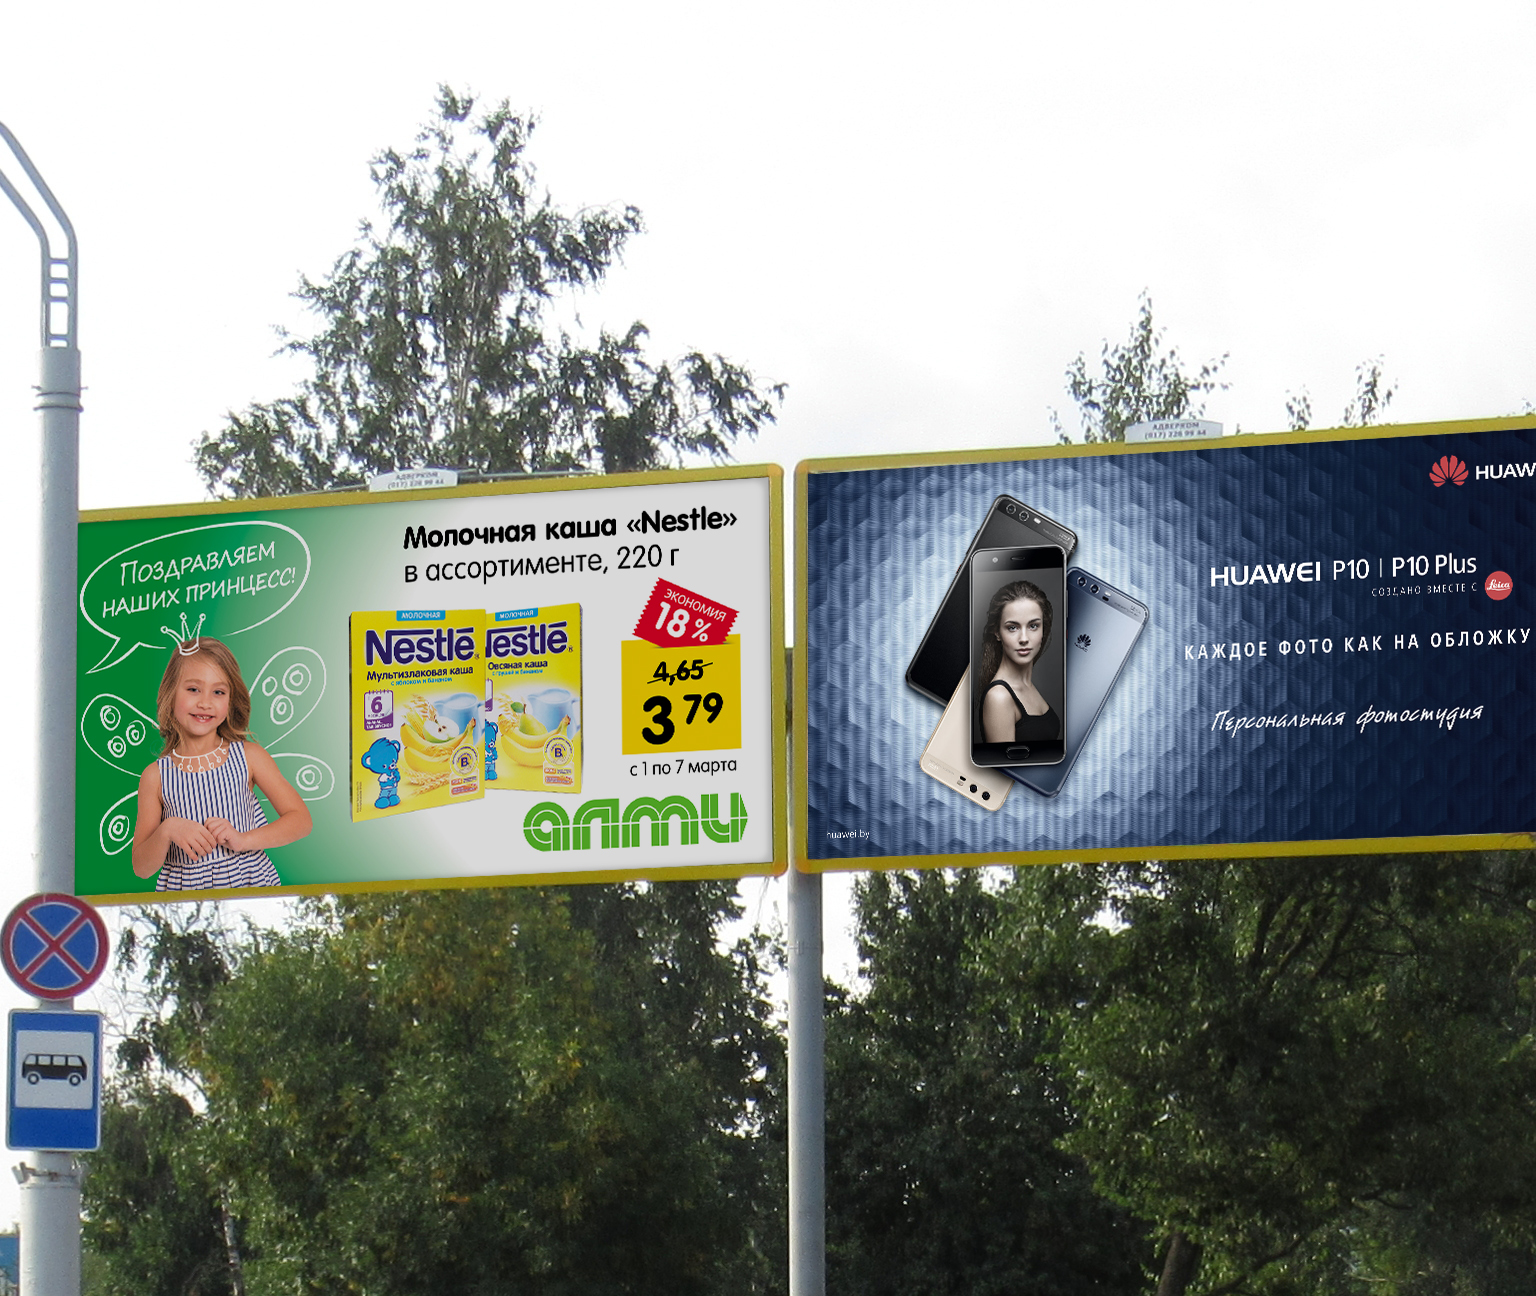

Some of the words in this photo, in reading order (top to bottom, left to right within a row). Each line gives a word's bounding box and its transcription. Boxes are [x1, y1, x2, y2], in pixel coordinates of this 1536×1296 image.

[403, 520, 536, 550] Молочная
[546, 518, 617, 541] каша
[404, 565, 418, 583] в
[425, 553, 608, 585] ассортименте,
[617, 544, 663, 570] 220
[670, 548, 680, 566] г
[1210, 561, 1321, 588] HUAWEI
[1332, 558, 1370, 581] P10
[1392, 555, 1429, 578] P10
[1435, 552, 1477, 575] Plus
[102, 588, 180, 618] НАШИХ
[185, 567, 297, 603] ПРИНЦЕСС!
[1371, 585, 1422, 597] СОЗДАНО
[1427, 582, 1467, 594] ВМЕСТЕ
[1486, 579, 1512, 592] Leica
[401, 612, 441, 620] МОЛОЧНАЯ
[499, 609, 534, 619] МОЛОЧНАЯ
[664, 588, 727, 623] ЭКОНОМИЯ
[1184, 641, 1268, 661] КАЖДОЕ
[1278, 638, 1333, 656] ФОТО
[1344, 635, 1382, 653] КАК
[1394, 633, 1419, 650] НА
[1430, 627, 1531, 649] ОБЛОЖКУ
[366, 667, 448, 683] Мультизлаковая
[449, 665, 474, 677] каша
[488, 662, 522, 671] Овсяная
[524, 660, 548, 668] каша
[652, 659, 705, 685] 4,65
[371, 696, 383, 714] 6
[641, 695, 675, 745] 3
[682, 692, 724, 725] 79
[1211, 709, 1347, 738] Персональная
[1356, 704, 1485, 734] фотостудия
[630, 763, 638, 776] с
[642, 761, 648, 776] 1
[652, 762, 671, 776] по
[676, 759, 685, 775] 7
[688, 758, 737, 776] марта
[827, 829, 870, 841] huawei.by
